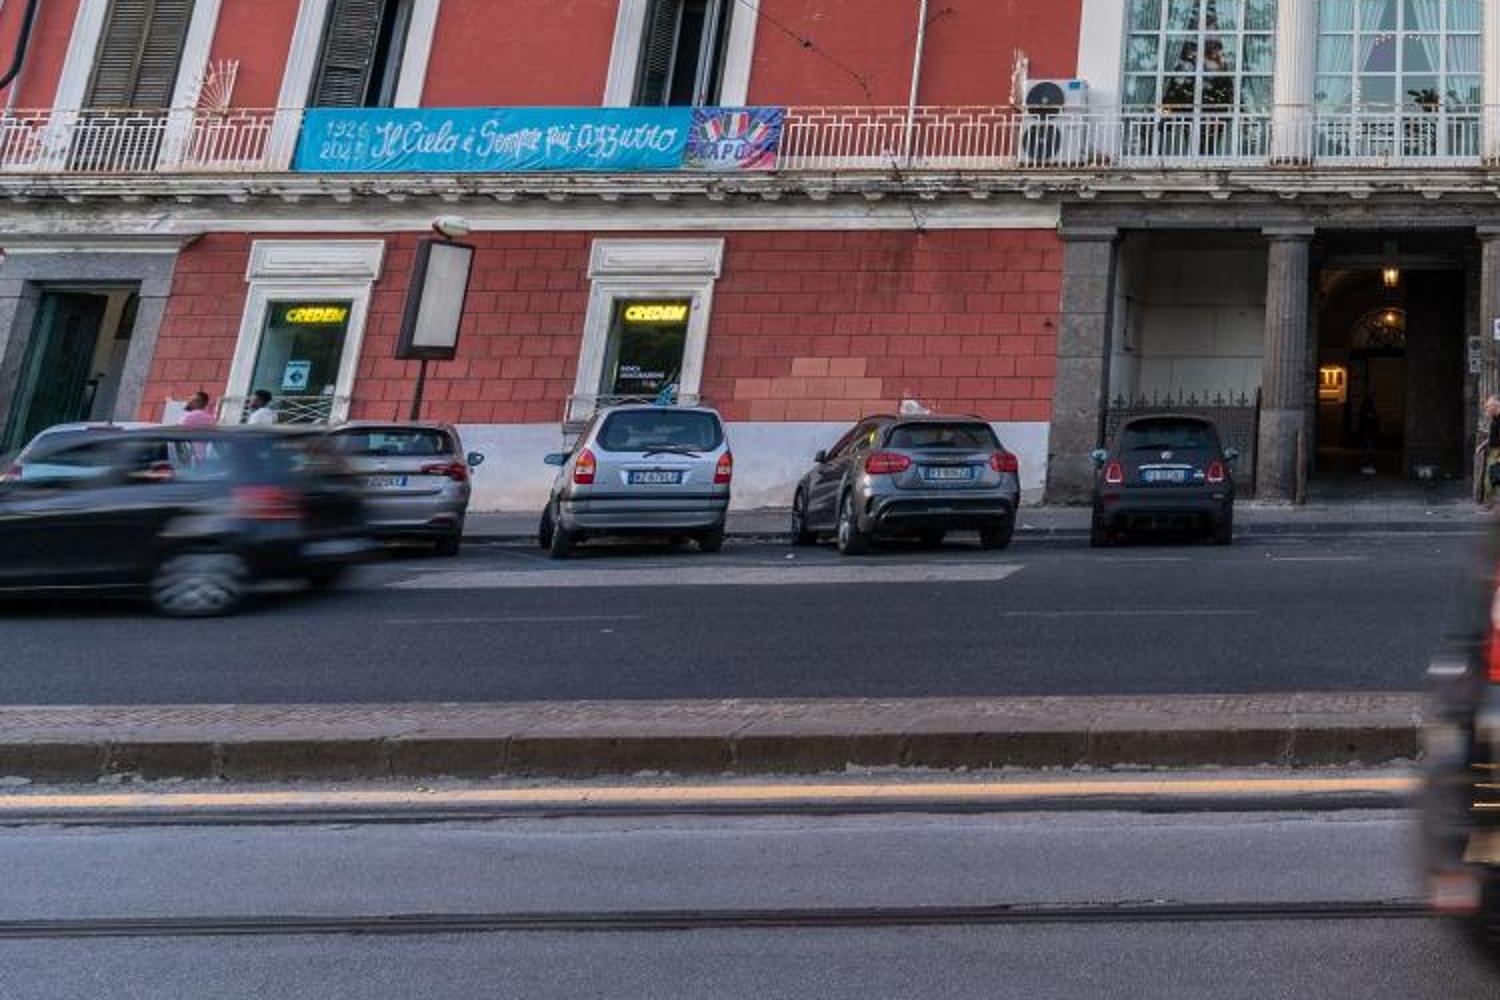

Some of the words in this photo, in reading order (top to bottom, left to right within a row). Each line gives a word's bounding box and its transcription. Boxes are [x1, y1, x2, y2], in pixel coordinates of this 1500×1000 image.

[402, 120, 461, 153] Cielo
[285, 307, 348, 323] CREDEM
[625, 305, 688, 321] CREDEM
